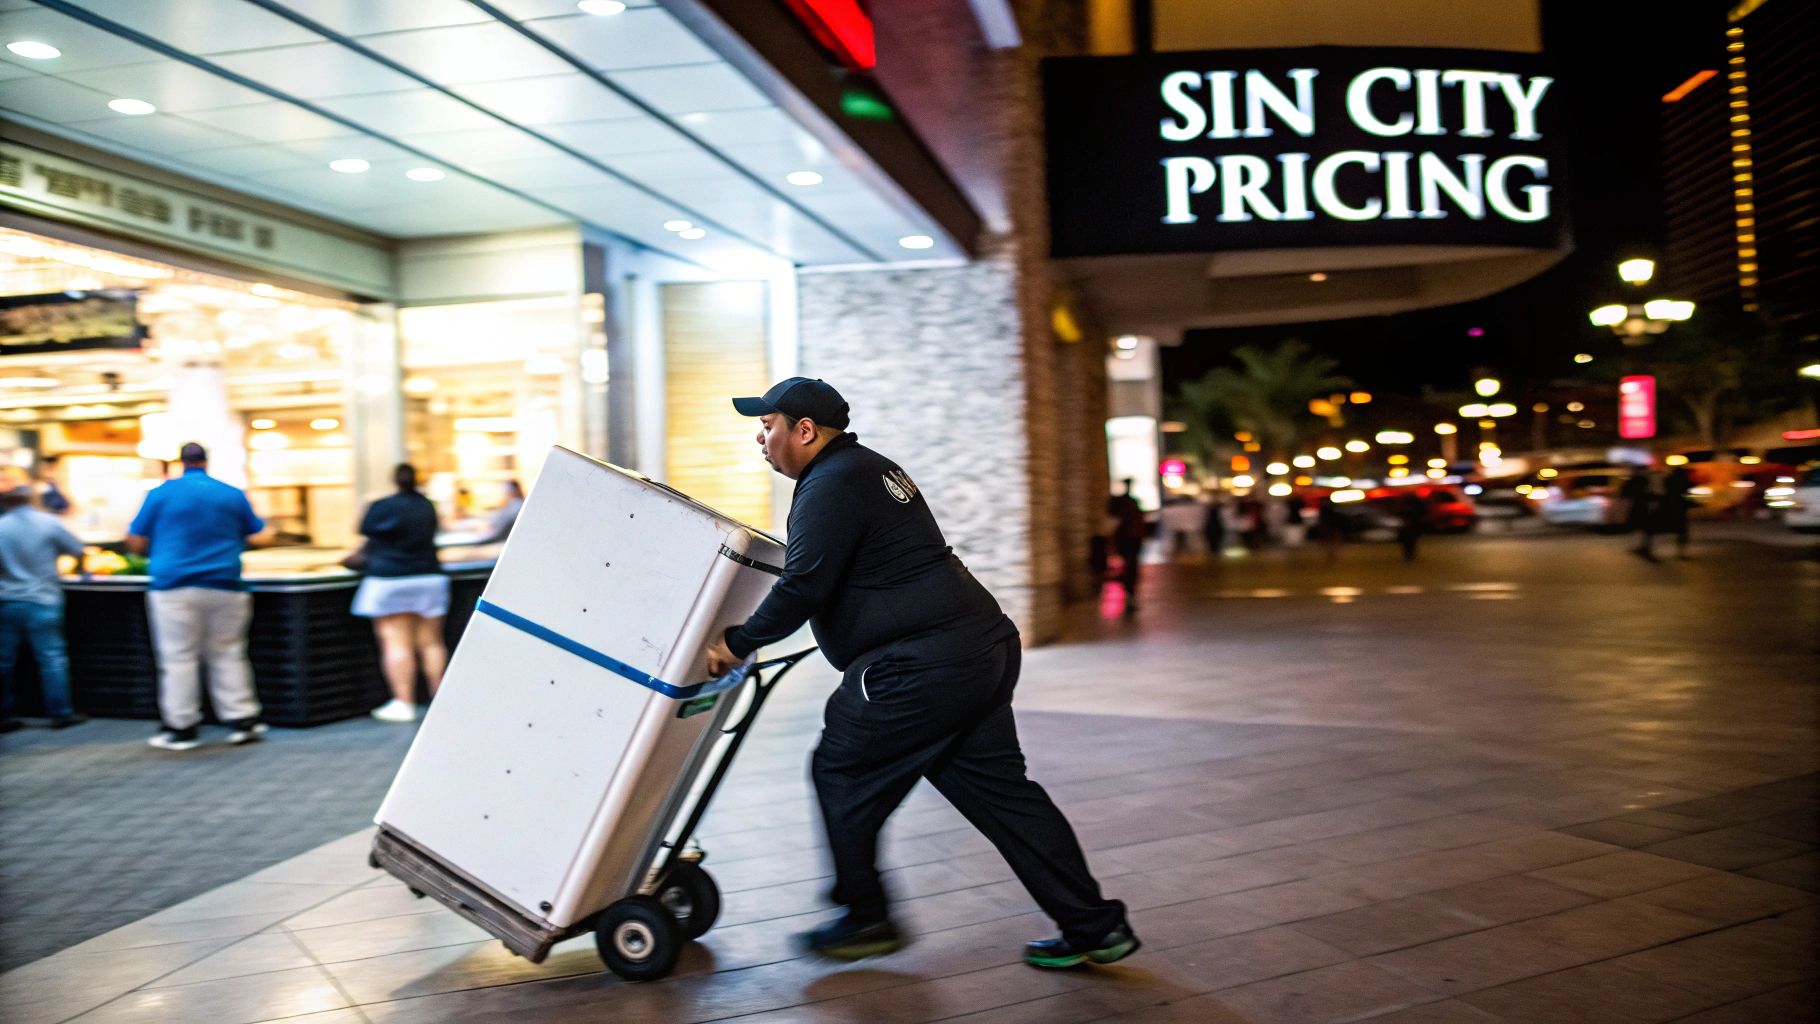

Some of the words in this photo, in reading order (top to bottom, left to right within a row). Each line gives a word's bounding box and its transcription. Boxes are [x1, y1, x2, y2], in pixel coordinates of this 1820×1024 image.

[1160, 68, 1319, 141] SIN
[1346, 67, 1554, 140] CITY
[1161, 150, 1552, 224] PRICING
